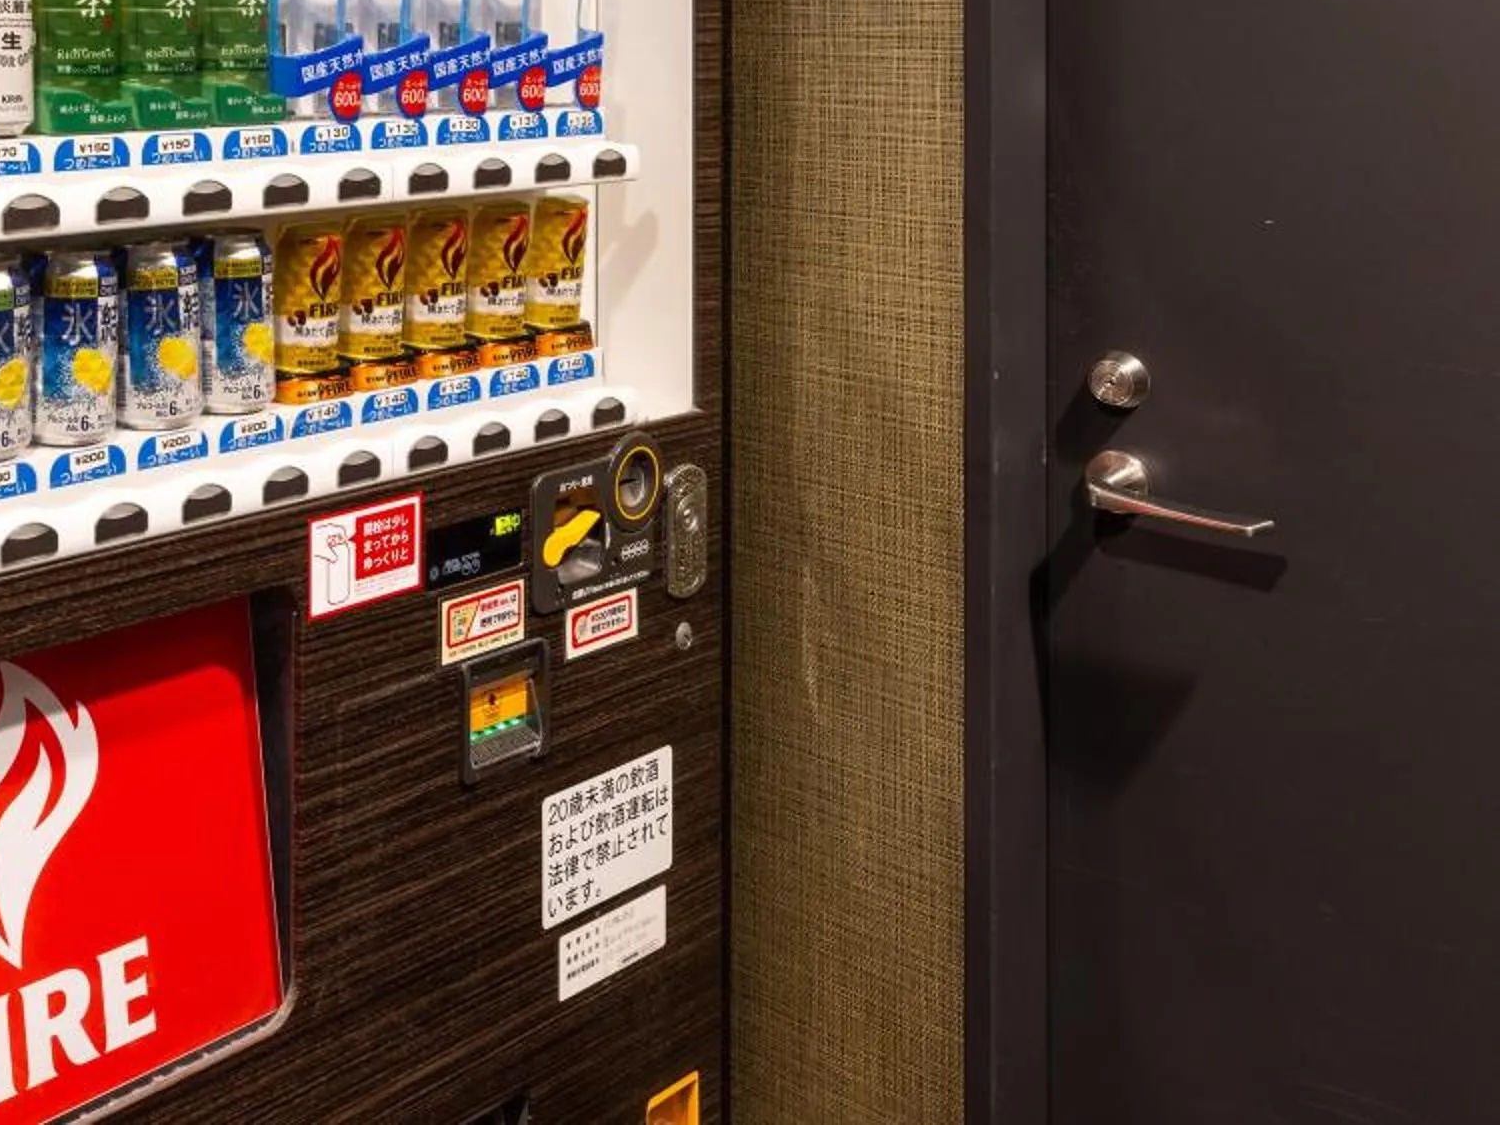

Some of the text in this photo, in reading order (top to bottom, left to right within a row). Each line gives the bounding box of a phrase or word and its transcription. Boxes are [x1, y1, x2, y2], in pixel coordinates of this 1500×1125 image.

[1, 31, 23, 50] 生
[145, 295, 175, 335] 氷
[232, 282, 260, 319] 氷
[61, 303, 93, 345] 氷
[75, 450, 105, 465] ¥200
[161, 435, 191, 449] ¥200
[548, 758, 659, 826] 20歳未満の飲酒
[548, 785, 669, 858] および飲酒運転は
[548, 813, 669, 890] 法律で禁止されて
[548, 878, 602, 918] います。
